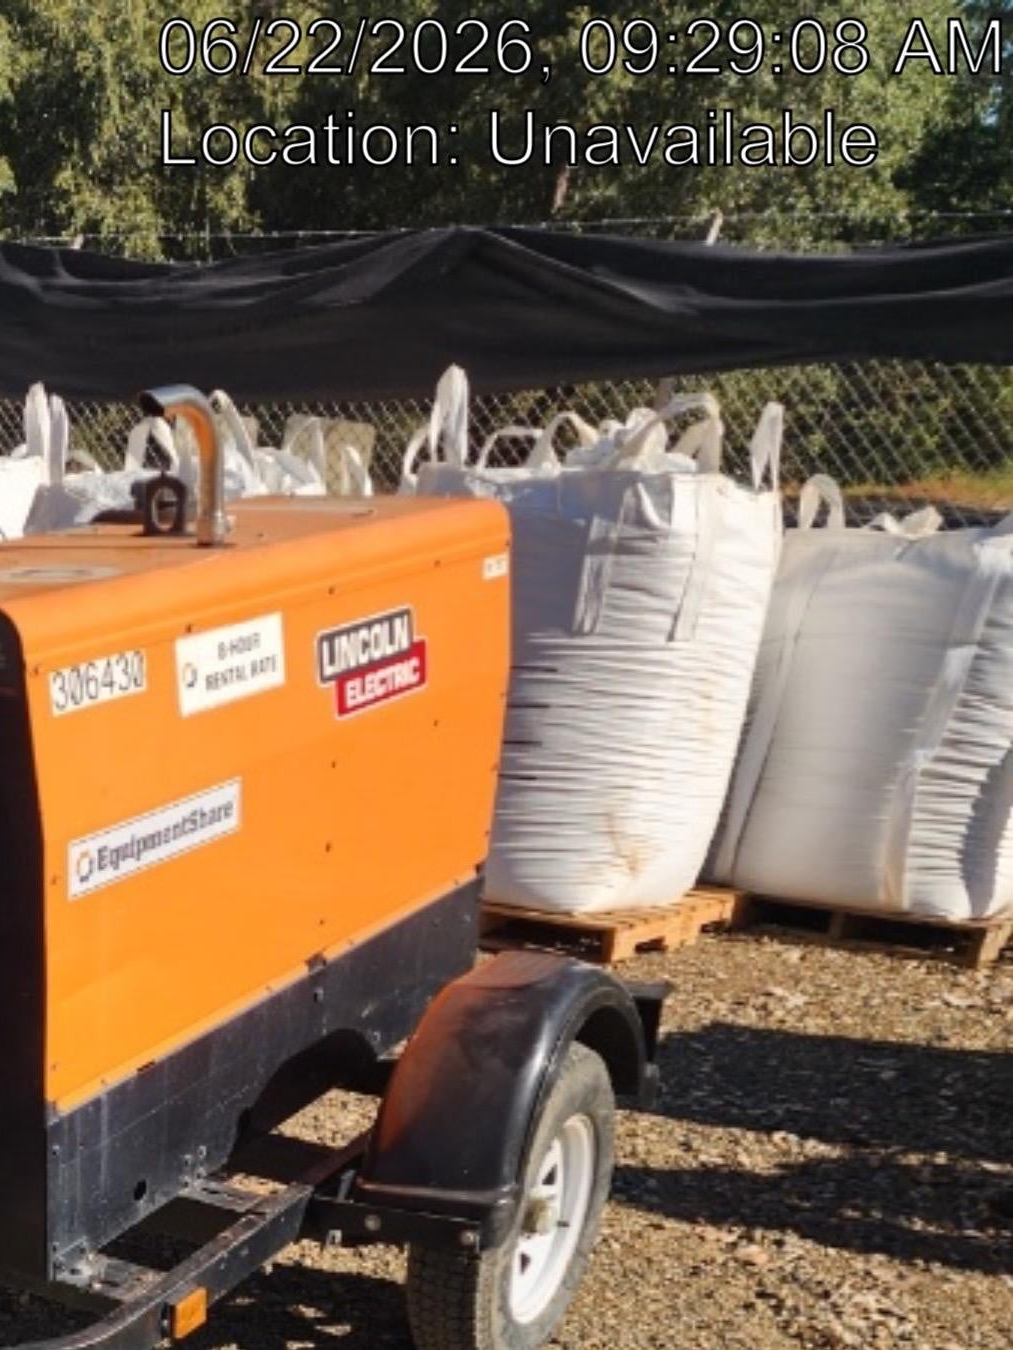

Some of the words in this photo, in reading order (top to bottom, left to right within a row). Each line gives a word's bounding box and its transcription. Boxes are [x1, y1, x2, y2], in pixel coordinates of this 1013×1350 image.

[205, 666, 249, 691] RENTAL
[250, 654, 277, 679] RATE
[322, 614, 409, 677] LINCOLN
[52, 650, 145, 712] 306430
[346, 657, 420, 708] ELECTRIC
[97, 800, 234, 870] EquipmentShare
